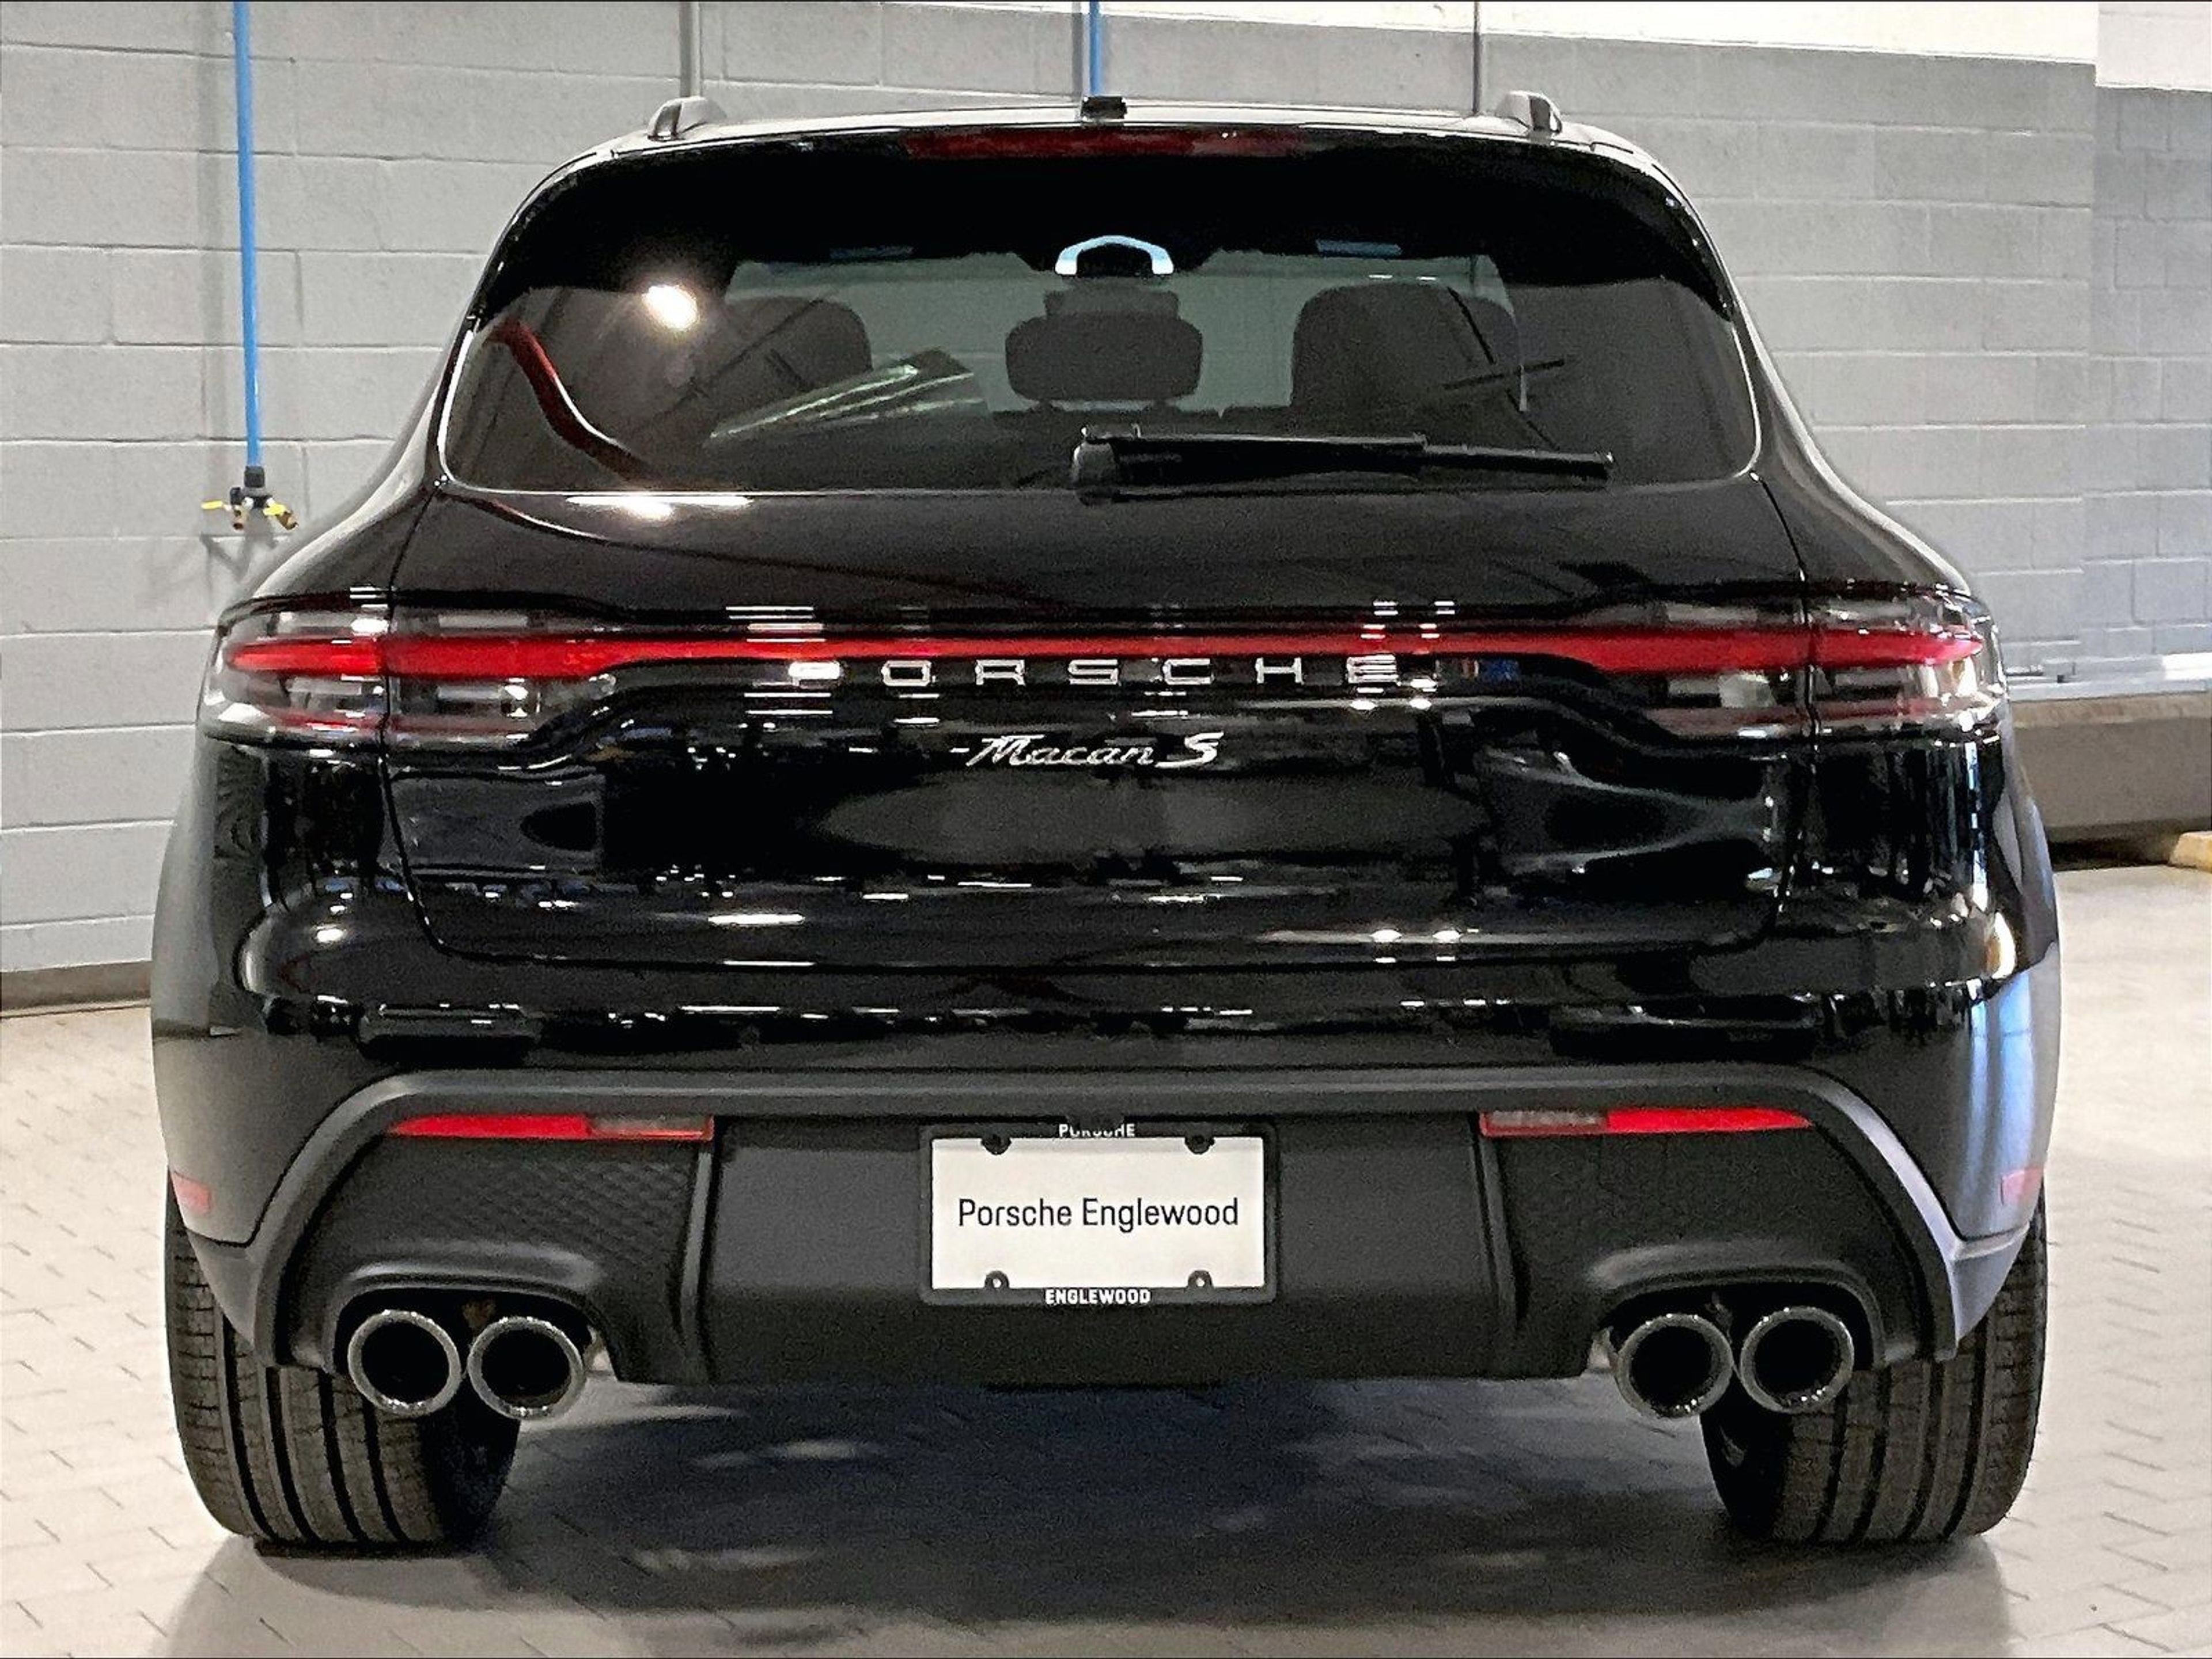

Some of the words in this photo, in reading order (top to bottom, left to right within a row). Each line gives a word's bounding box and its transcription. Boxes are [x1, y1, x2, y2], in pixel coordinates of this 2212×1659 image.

[787, 653, 1399, 686] PORSCHE
[965, 734, 1153, 766] Macan
[1154, 732, 1225, 768] S
[959, 1198, 1072, 1226] Porsche
[1083, 1197, 1239, 1233] Englewood
[1045, 1288, 1151, 1305] ENGLEWOOD
